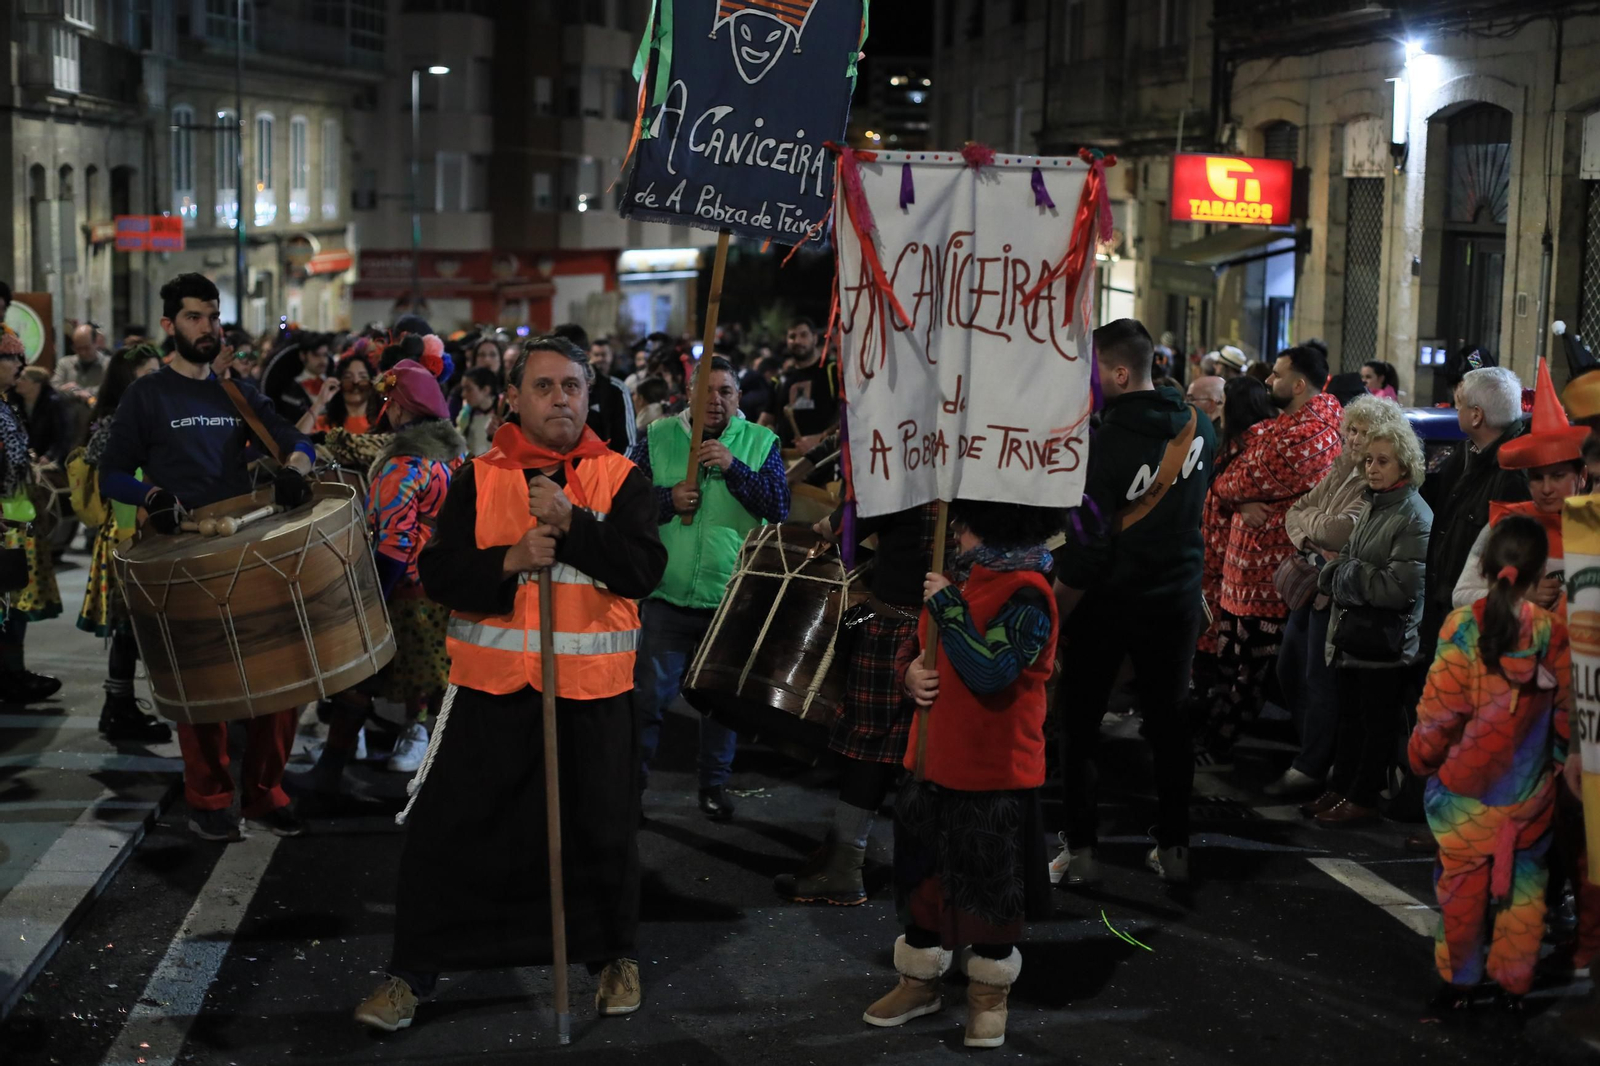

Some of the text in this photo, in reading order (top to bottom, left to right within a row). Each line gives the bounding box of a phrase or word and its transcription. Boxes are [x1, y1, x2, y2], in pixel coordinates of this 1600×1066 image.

[650, 79, 688, 175] A
[635, 181, 660, 208] de
[665, 178, 687, 213] A
[694, 184, 748, 226] Pobra
[750, 201, 773, 227] de
[1188, 199, 1273, 219] TABACOS
[170, 414, 242, 428] carhartt
[869, 419, 1084, 481] A POBRA DE TRIVES
